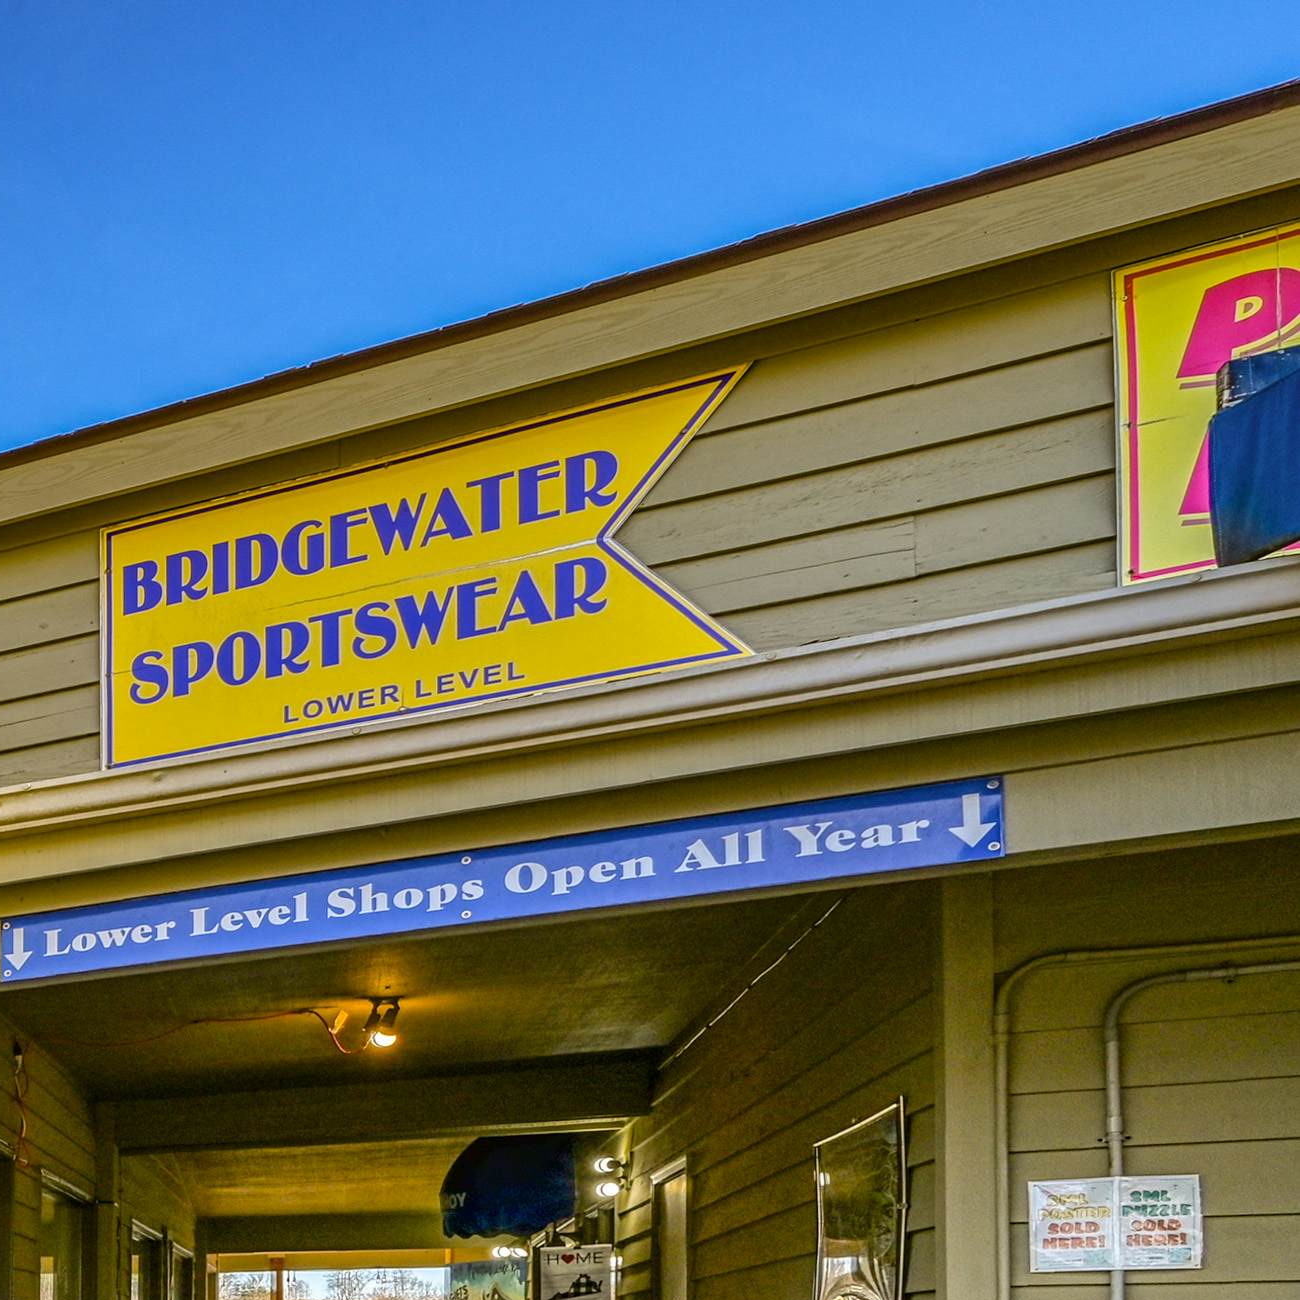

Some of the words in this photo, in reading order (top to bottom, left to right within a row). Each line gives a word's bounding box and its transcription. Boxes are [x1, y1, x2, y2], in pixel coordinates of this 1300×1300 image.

[122, 450, 619, 616] BRIDGEWATER
[129, 556, 608, 705] SPORTSWEAR
[283, 683, 400, 724] LOWER
[414, 661, 526, 698] LEVEL
[43, 919, 177, 957] Lower
[189, 892, 309, 937] Level
[326, 879, 484, 920] Shops
[504, 855, 656, 896] Open
[675, 828, 766, 873] All
[783, 818, 930, 858] Year
[1042, 1235, 1107, 1250] HERE!
[1048, 1222, 1101, 1234] SOLD
[1130, 1219, 1182, 1232] SOLD
